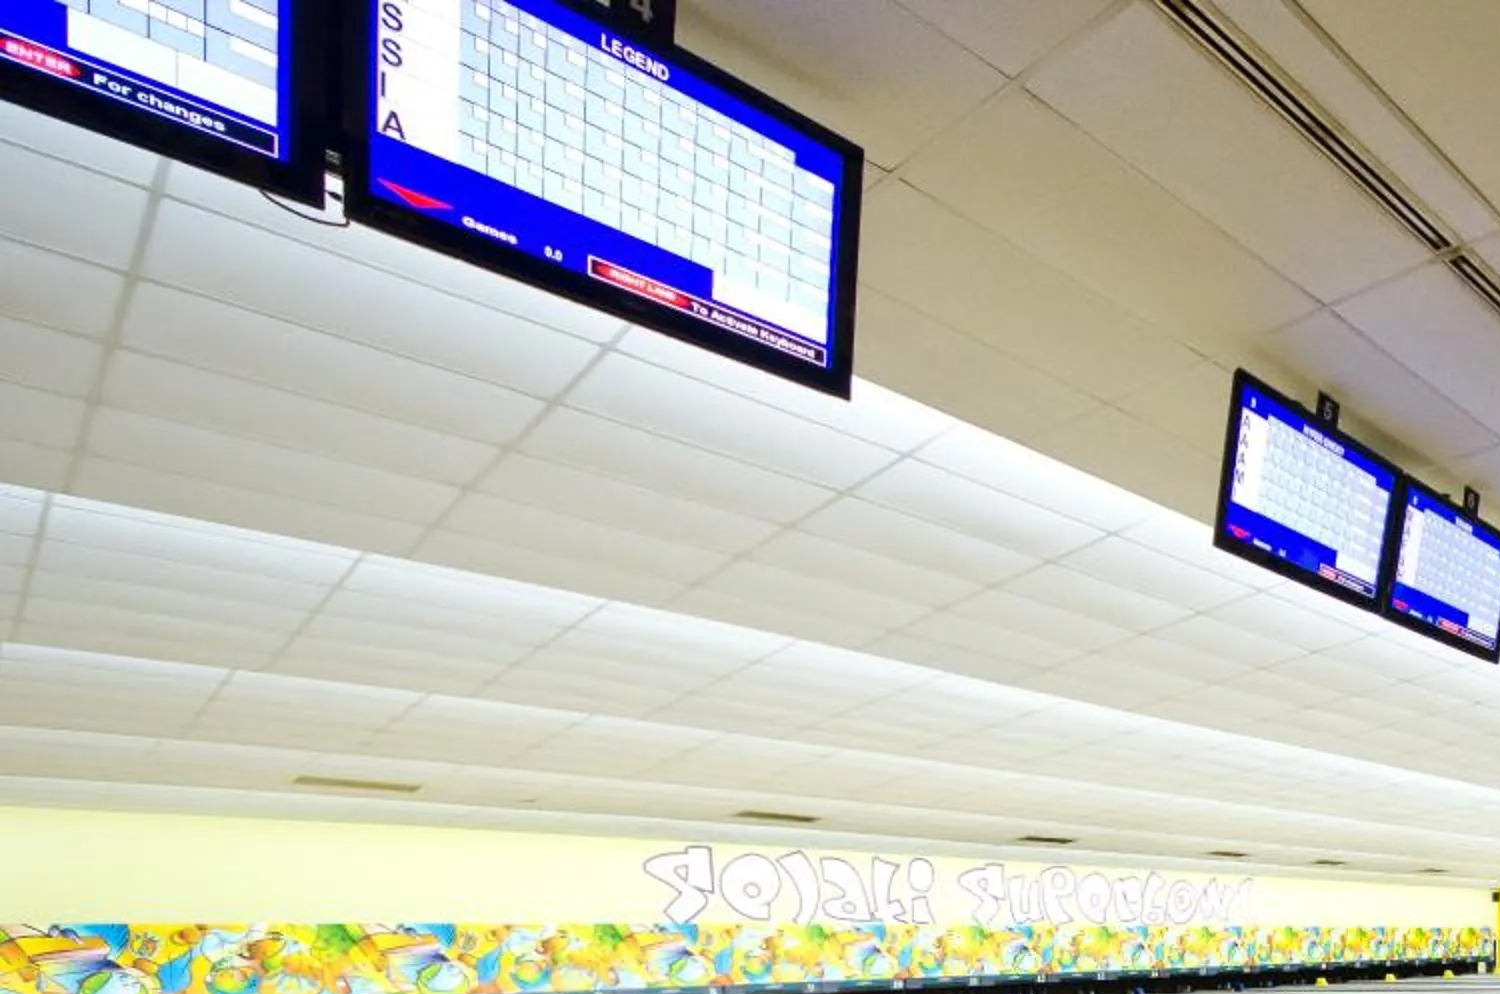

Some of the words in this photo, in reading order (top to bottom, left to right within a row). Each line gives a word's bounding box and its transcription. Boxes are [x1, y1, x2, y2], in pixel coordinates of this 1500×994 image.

[381, 37, 403, 67] S
[600, 32, 670, 82] LEGEND
[6, 39, 72, 76] ENTER
[92, 73, 132, 95] For
[137, 87, 227, 132] changes
[382, 109, 406, 140] A
[461, 215, 518, 245] Games
[690, 301, 709, 316] To
